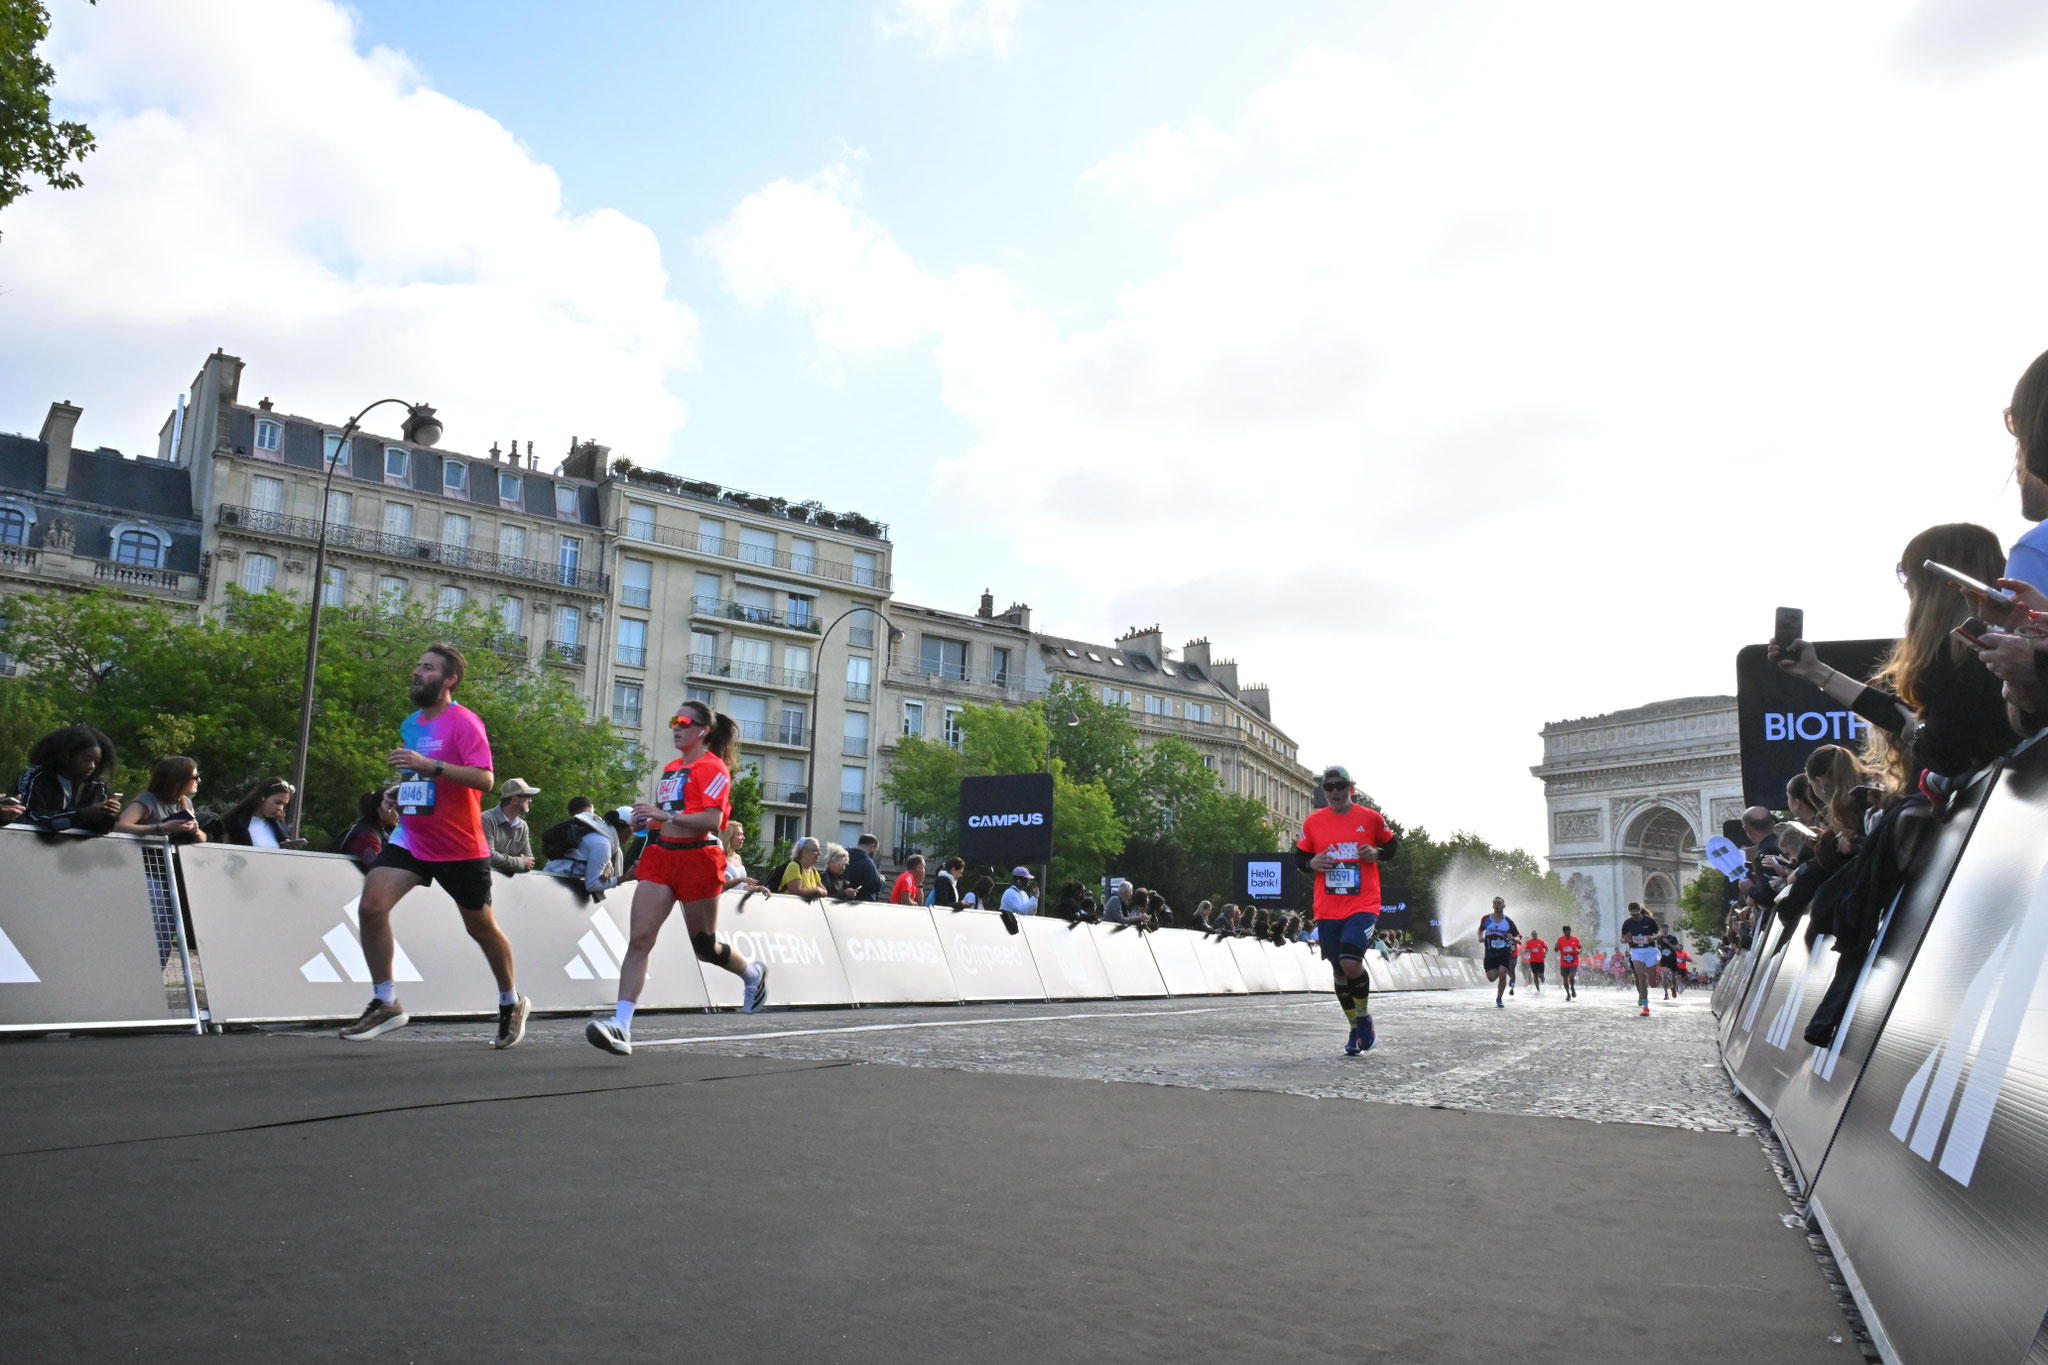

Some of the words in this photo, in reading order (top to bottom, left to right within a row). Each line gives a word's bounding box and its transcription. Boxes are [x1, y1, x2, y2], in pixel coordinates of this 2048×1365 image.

[1765, 711, 1872, 740] BIOTH
[968, 813, 1044, 828] CAMPUS
[1251, 869, 1276, 878] Hello
[1329, 870, 1350, 882] 13591
[1251, 879, 1278, 888] bank!
[1380, 904, 1397, 912] aysia
[847, 937, 937, 964] CAMPUS
[954, 934, 1024, 974] Compeed
